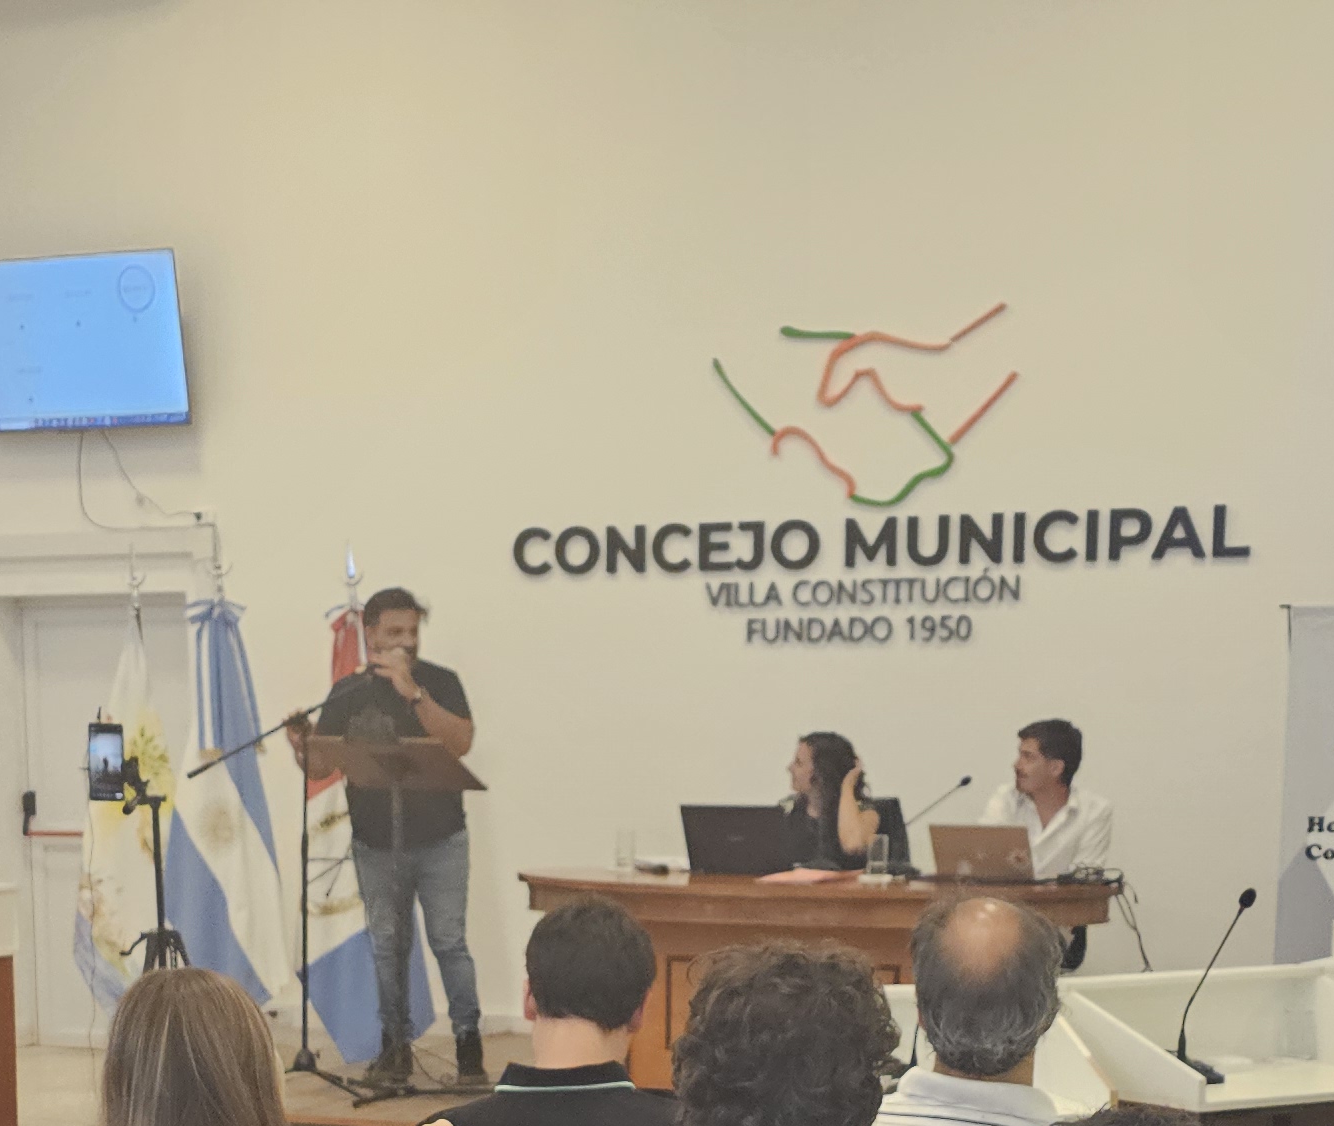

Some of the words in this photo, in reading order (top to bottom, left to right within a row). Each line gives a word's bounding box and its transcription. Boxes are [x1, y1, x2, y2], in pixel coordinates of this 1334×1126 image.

[513, 519, 821, 576] CONCEJO
[844, 504, 1251, 568] MUNICIPAL
[705, 581, 783, 607] VILLA
[792, 569, 1021, 606] CONSTITUCIÓN
[746, 615, 893, 644] FUNDADO
[906, 614, 973, 643] 1950
